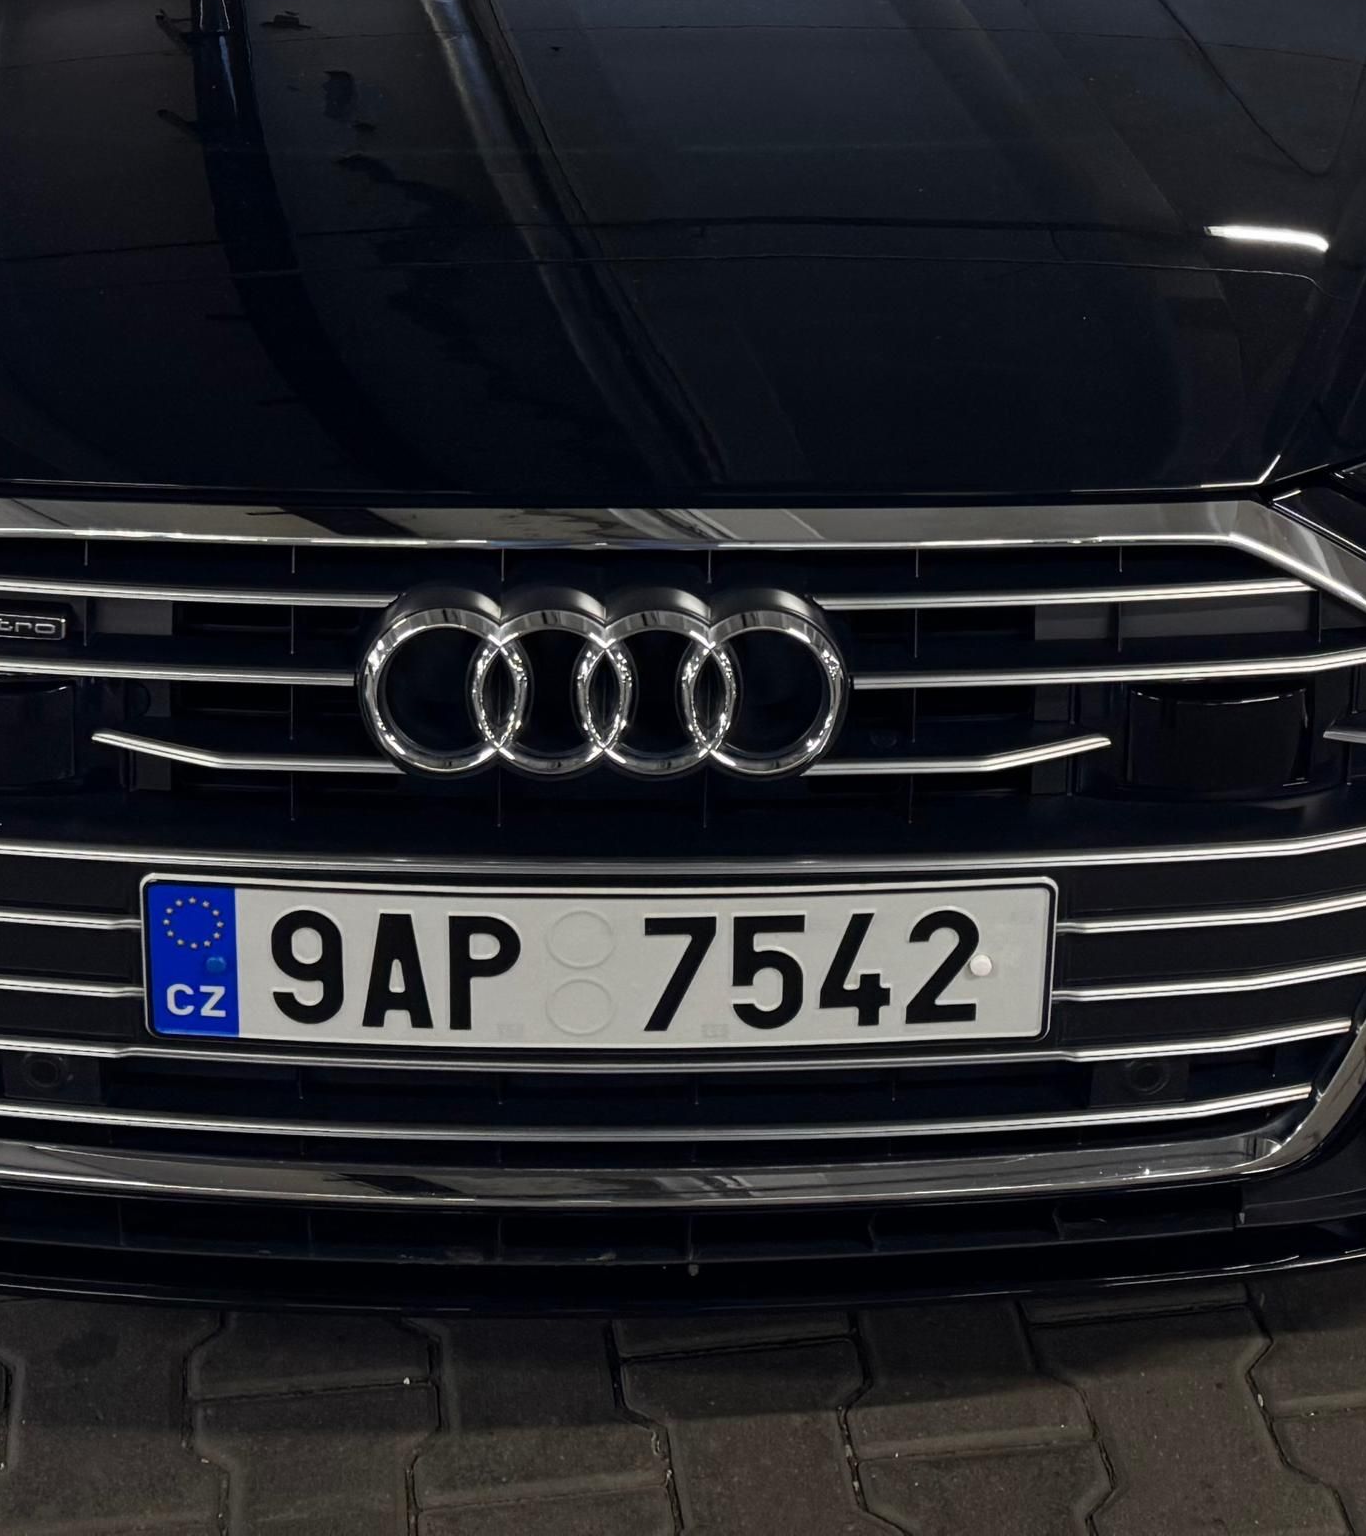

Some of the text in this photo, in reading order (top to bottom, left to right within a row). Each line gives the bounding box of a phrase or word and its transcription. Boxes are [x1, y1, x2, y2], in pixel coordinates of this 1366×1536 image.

[165, 983, 227, 1020] CZ
[269, 907, 981, 1033] 9AP 7542
